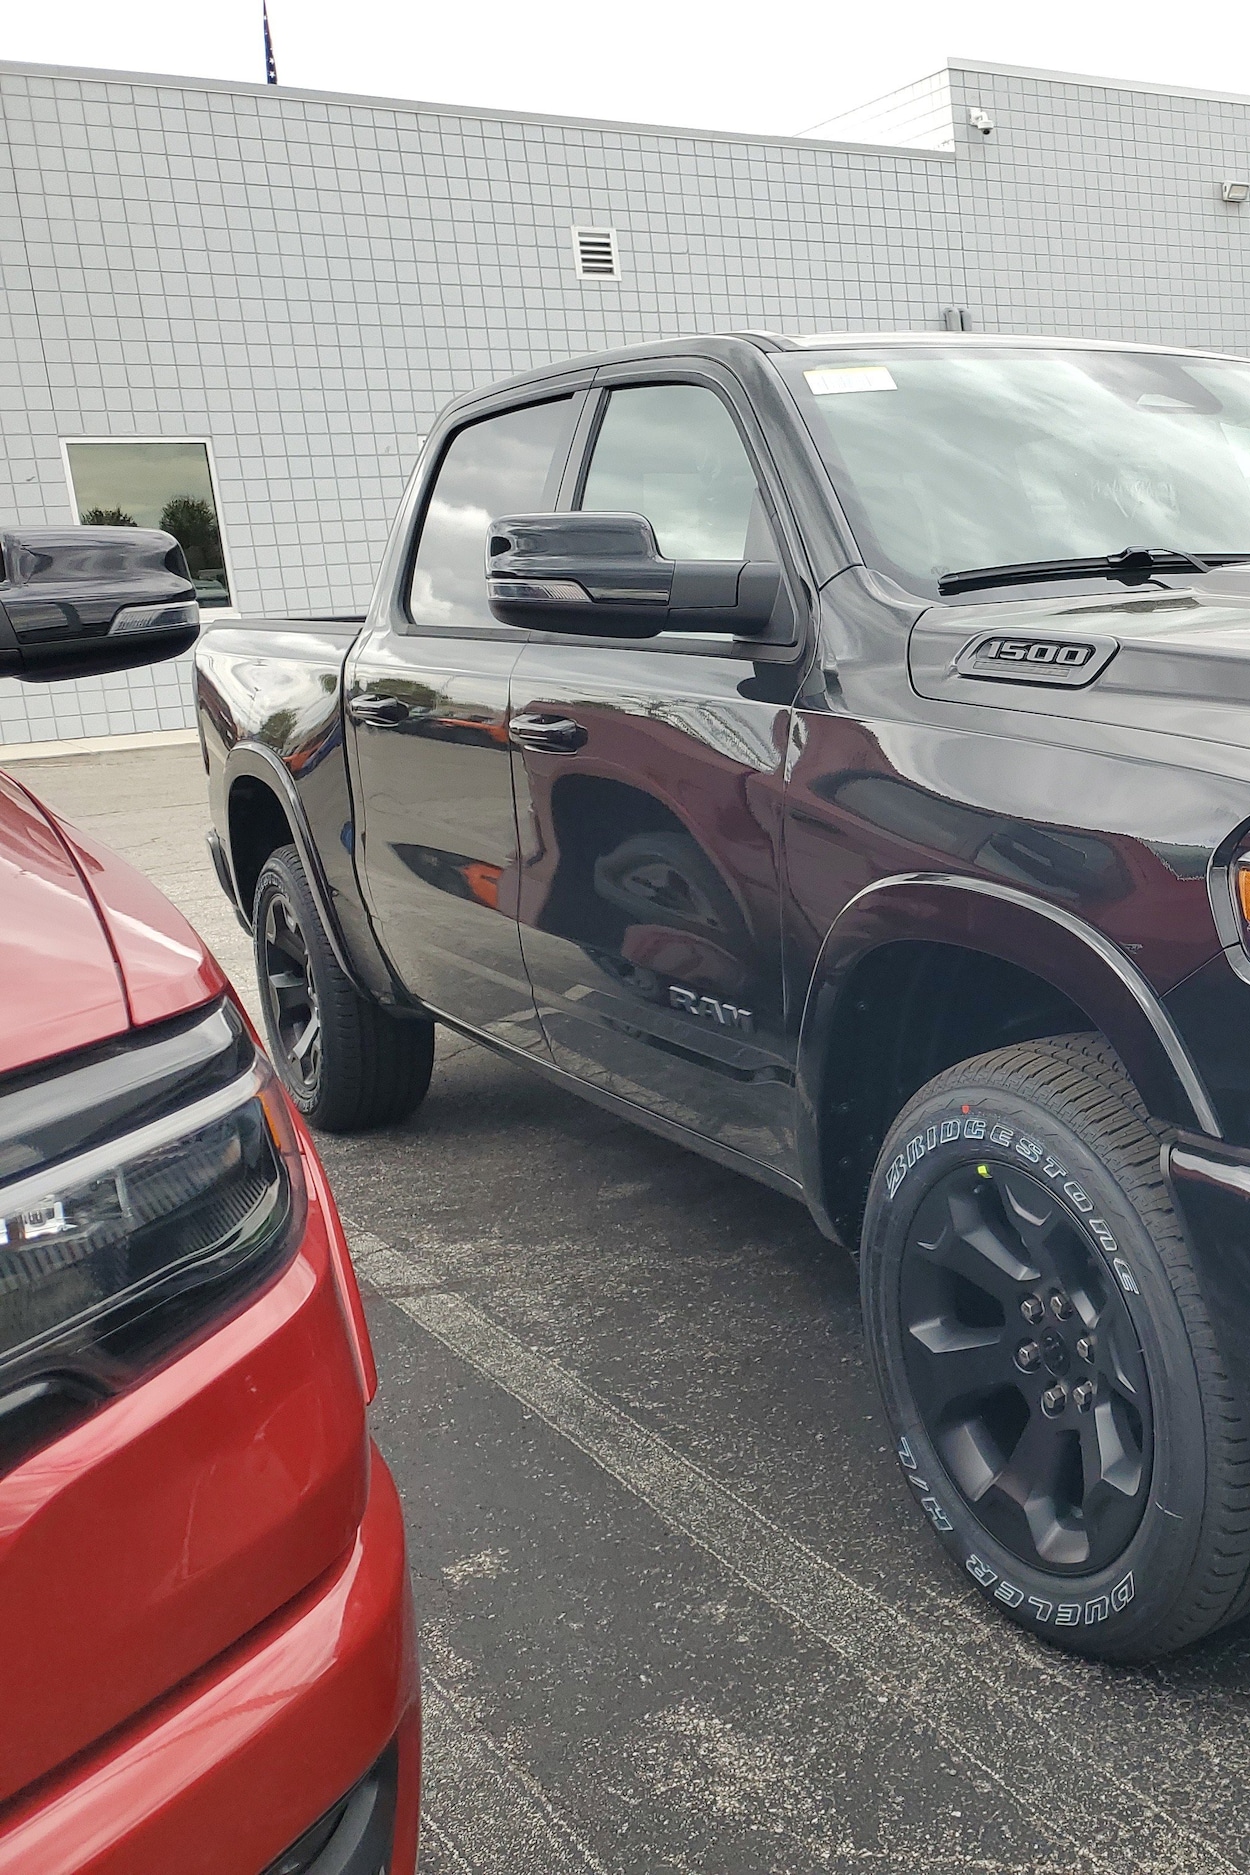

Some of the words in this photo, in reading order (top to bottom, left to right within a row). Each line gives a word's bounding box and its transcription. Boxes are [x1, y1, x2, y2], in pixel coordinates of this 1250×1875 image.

[986, 640, 1090, 666] 1500
[668, 985, 752, 1033] RAM
[885, 1118, 1141, 1296] BRIDGESTONE
[965, 1553, 1136, 1627] DUELER
